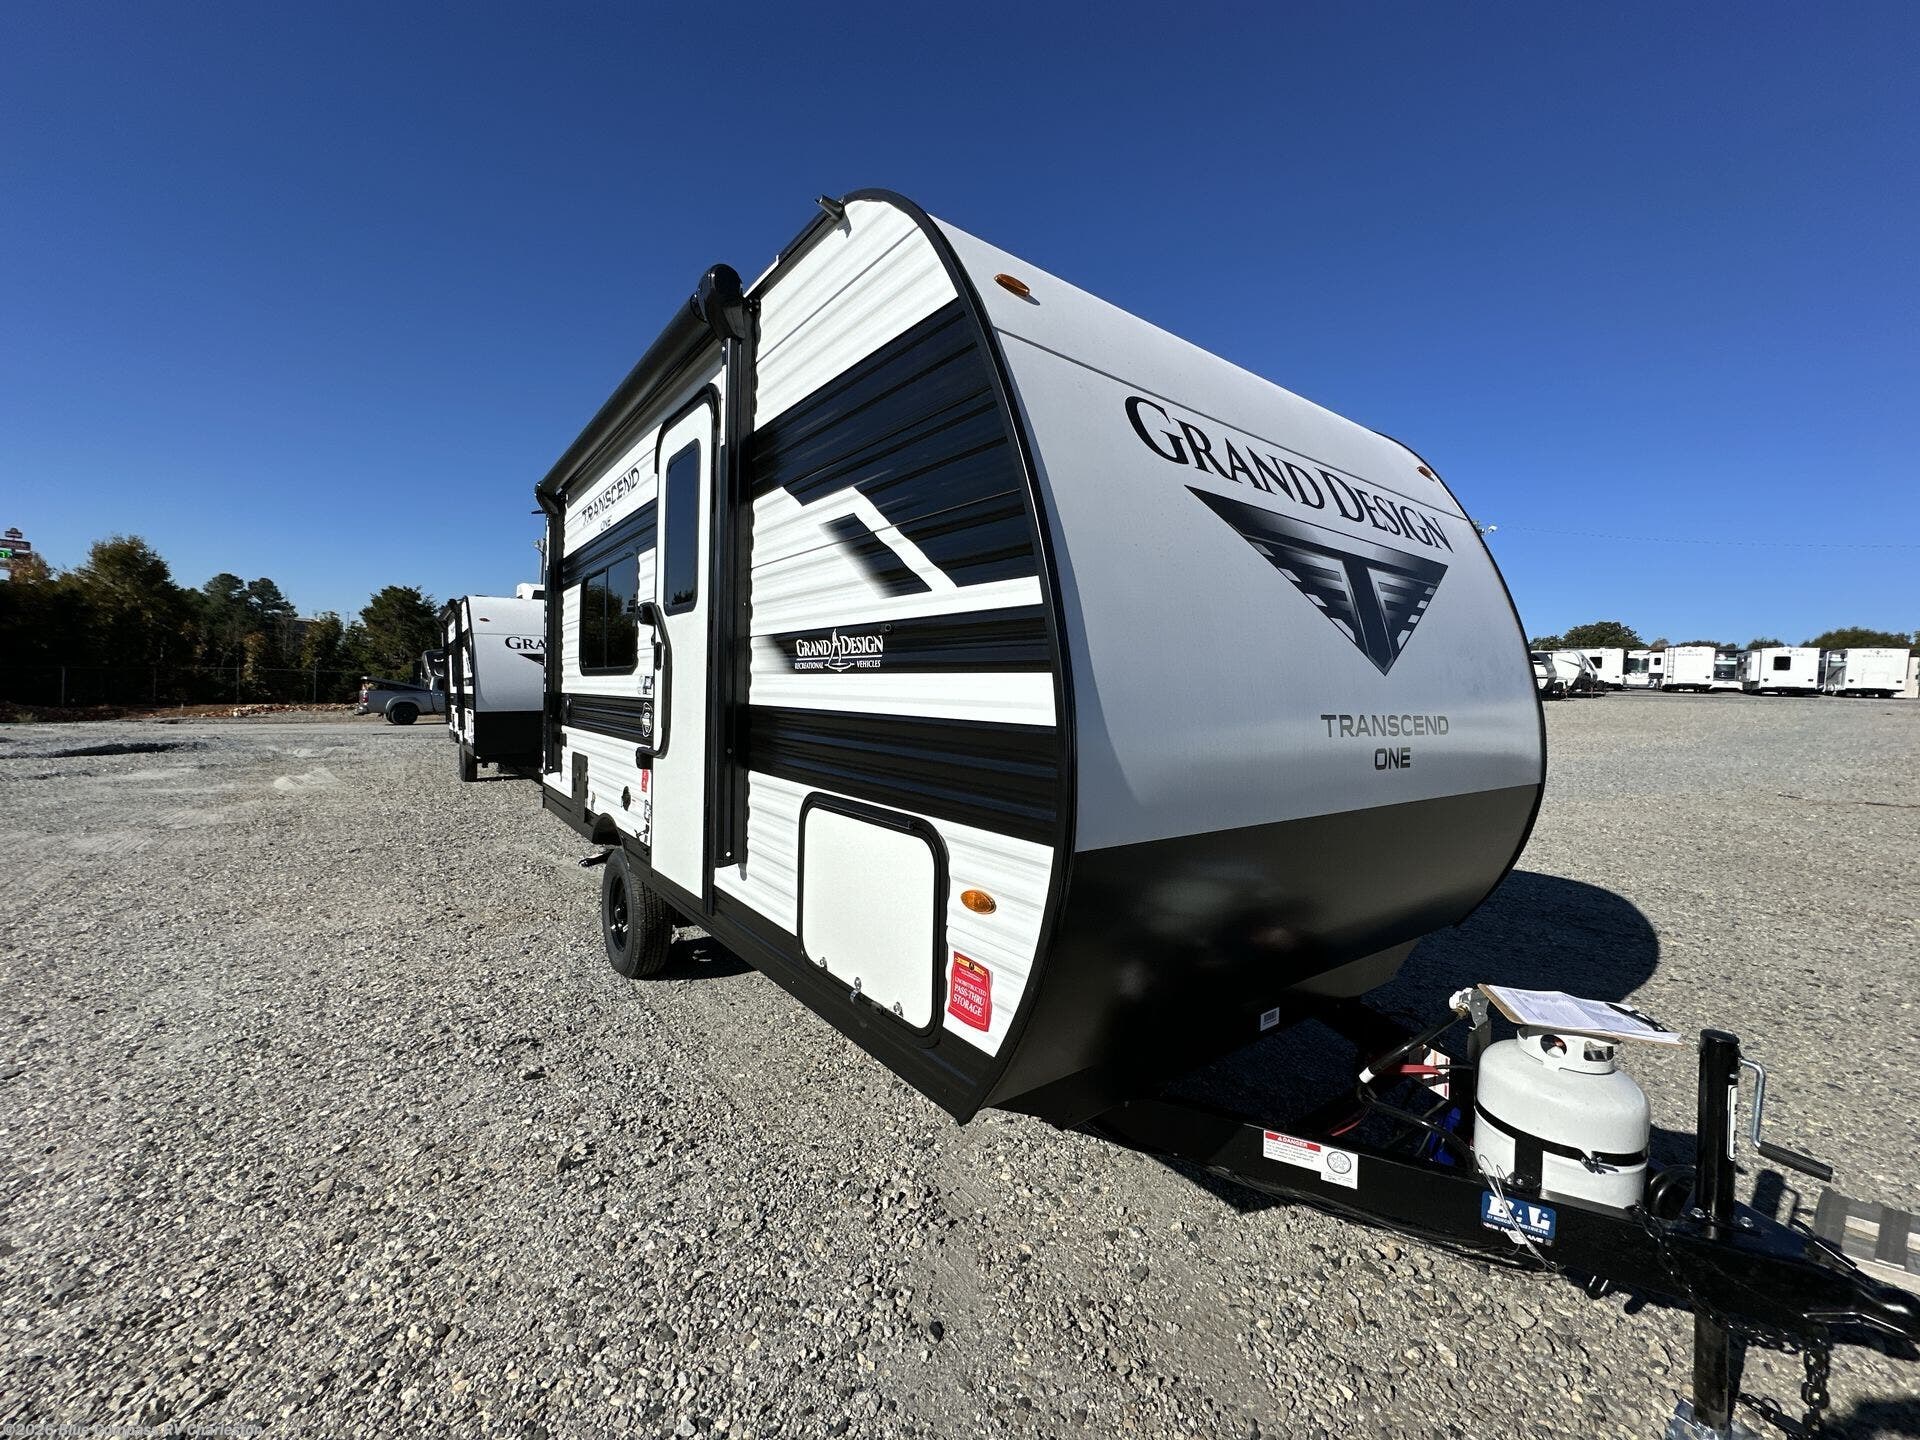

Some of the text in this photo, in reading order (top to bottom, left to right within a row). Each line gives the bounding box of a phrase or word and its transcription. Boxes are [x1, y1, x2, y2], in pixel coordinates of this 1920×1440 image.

[1124, 395, 1454, 553] GRAND DESIGN
[582, 467, 640, 528] TRANSCEND
[504, 636, 545, 650] GRA
[796, 635, 884, 657] GRAND DESIGN
[794, 660, 881, 670] RECREATIONAL VEHICLES
[1320, 713, 1449, 738] TRANSCEND
[1373, 747, 1411, 770] ONE
[953, 993, 983, 1017] STORAGE
[954, 983, 986, 1006] PASS-THRU
[1282, 1136, 1308, 1148] DANGER
